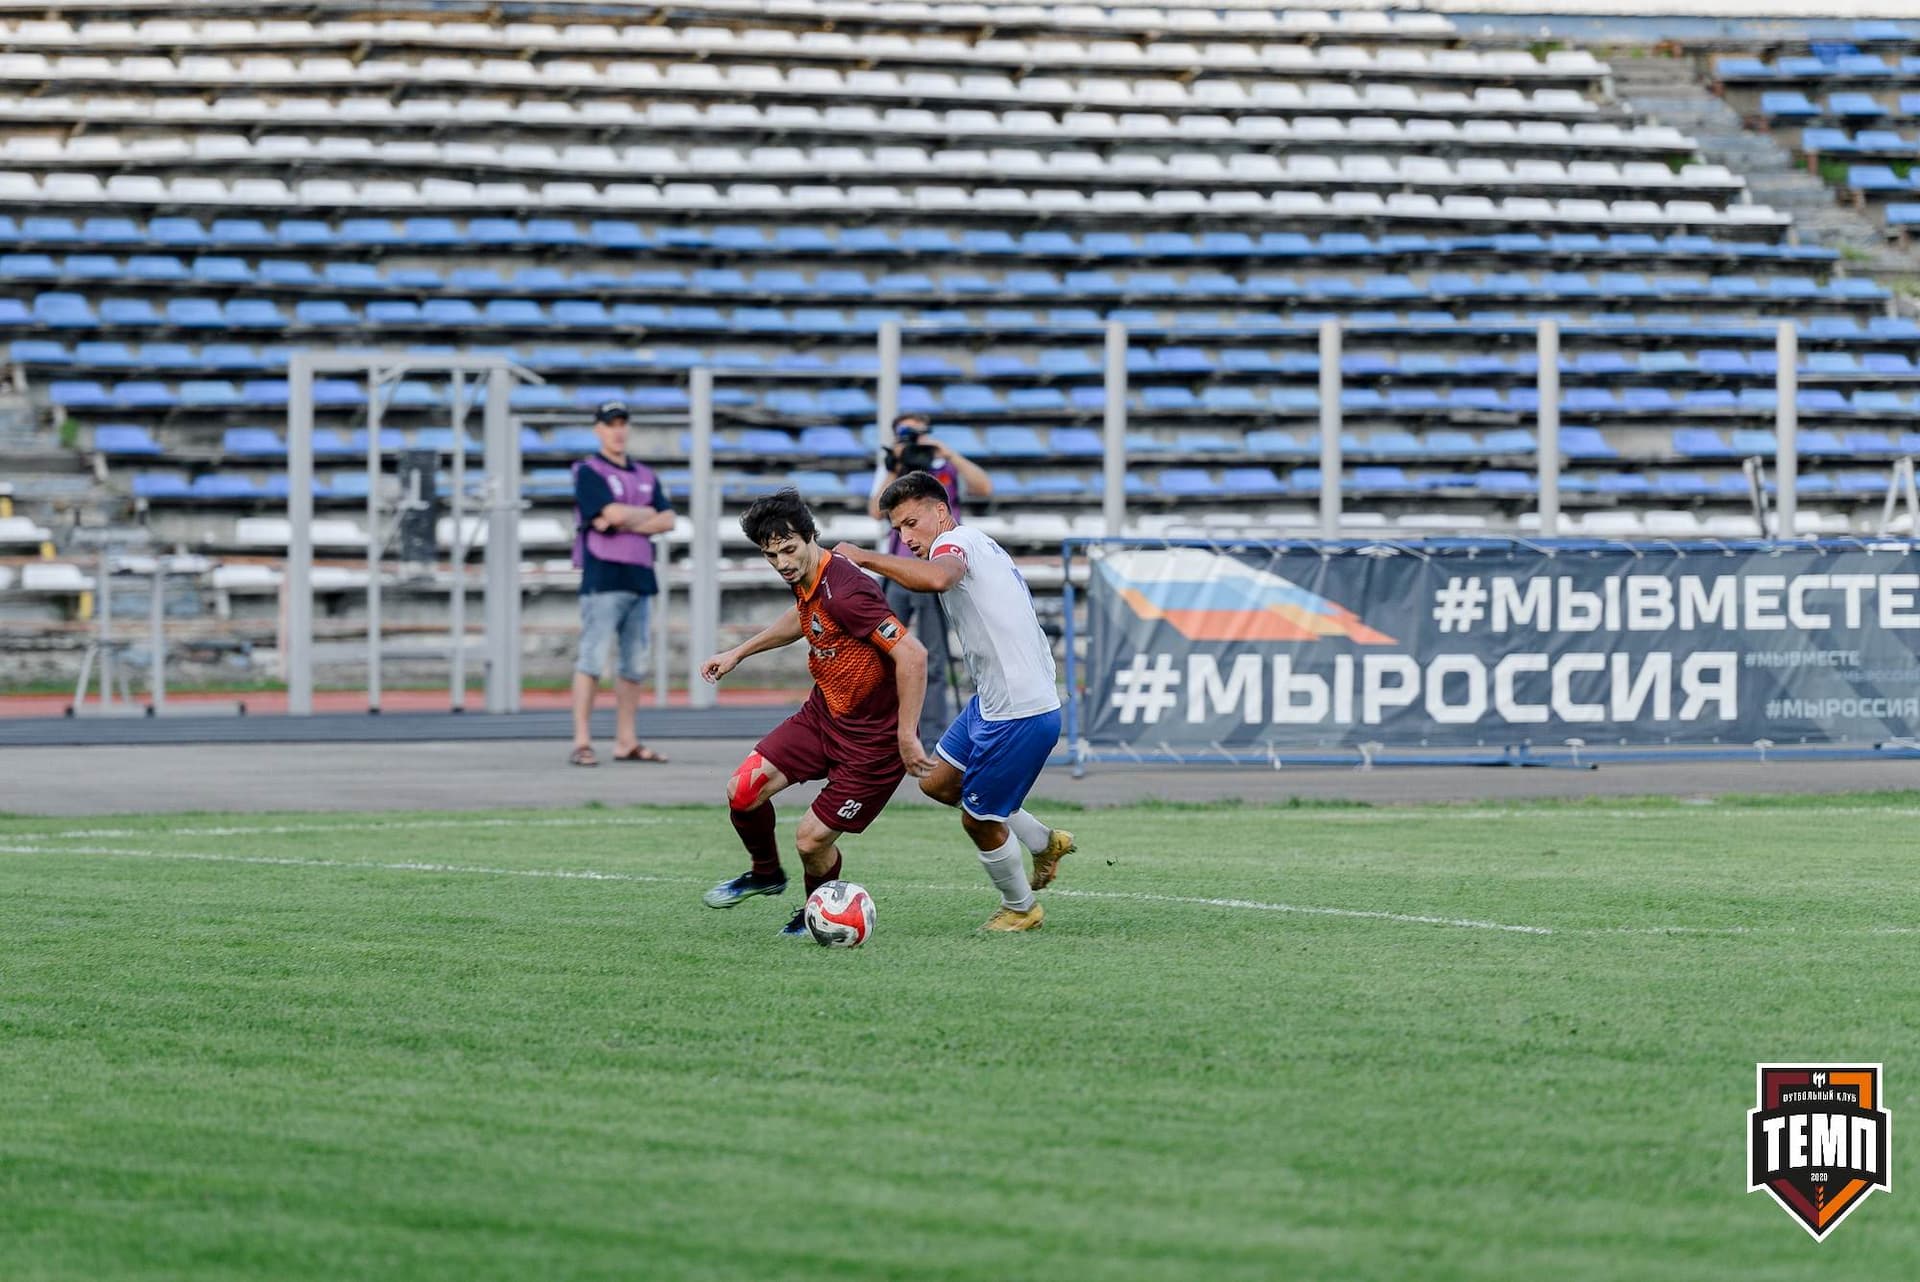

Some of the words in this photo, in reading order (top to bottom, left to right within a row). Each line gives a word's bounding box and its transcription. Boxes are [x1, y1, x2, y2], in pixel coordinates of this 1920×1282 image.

[1433, 574, 1920, 632] #МЫВМЕСТЕ
[1744, 651, 1861, 667] #МЫВМЕСТЕ
[1111, 652, 1738, 724] #МЫРОССИЯ
[1766, 699, 1919, 719] #МЫРОССИЯ
[837, 799, 863, 819] 23
